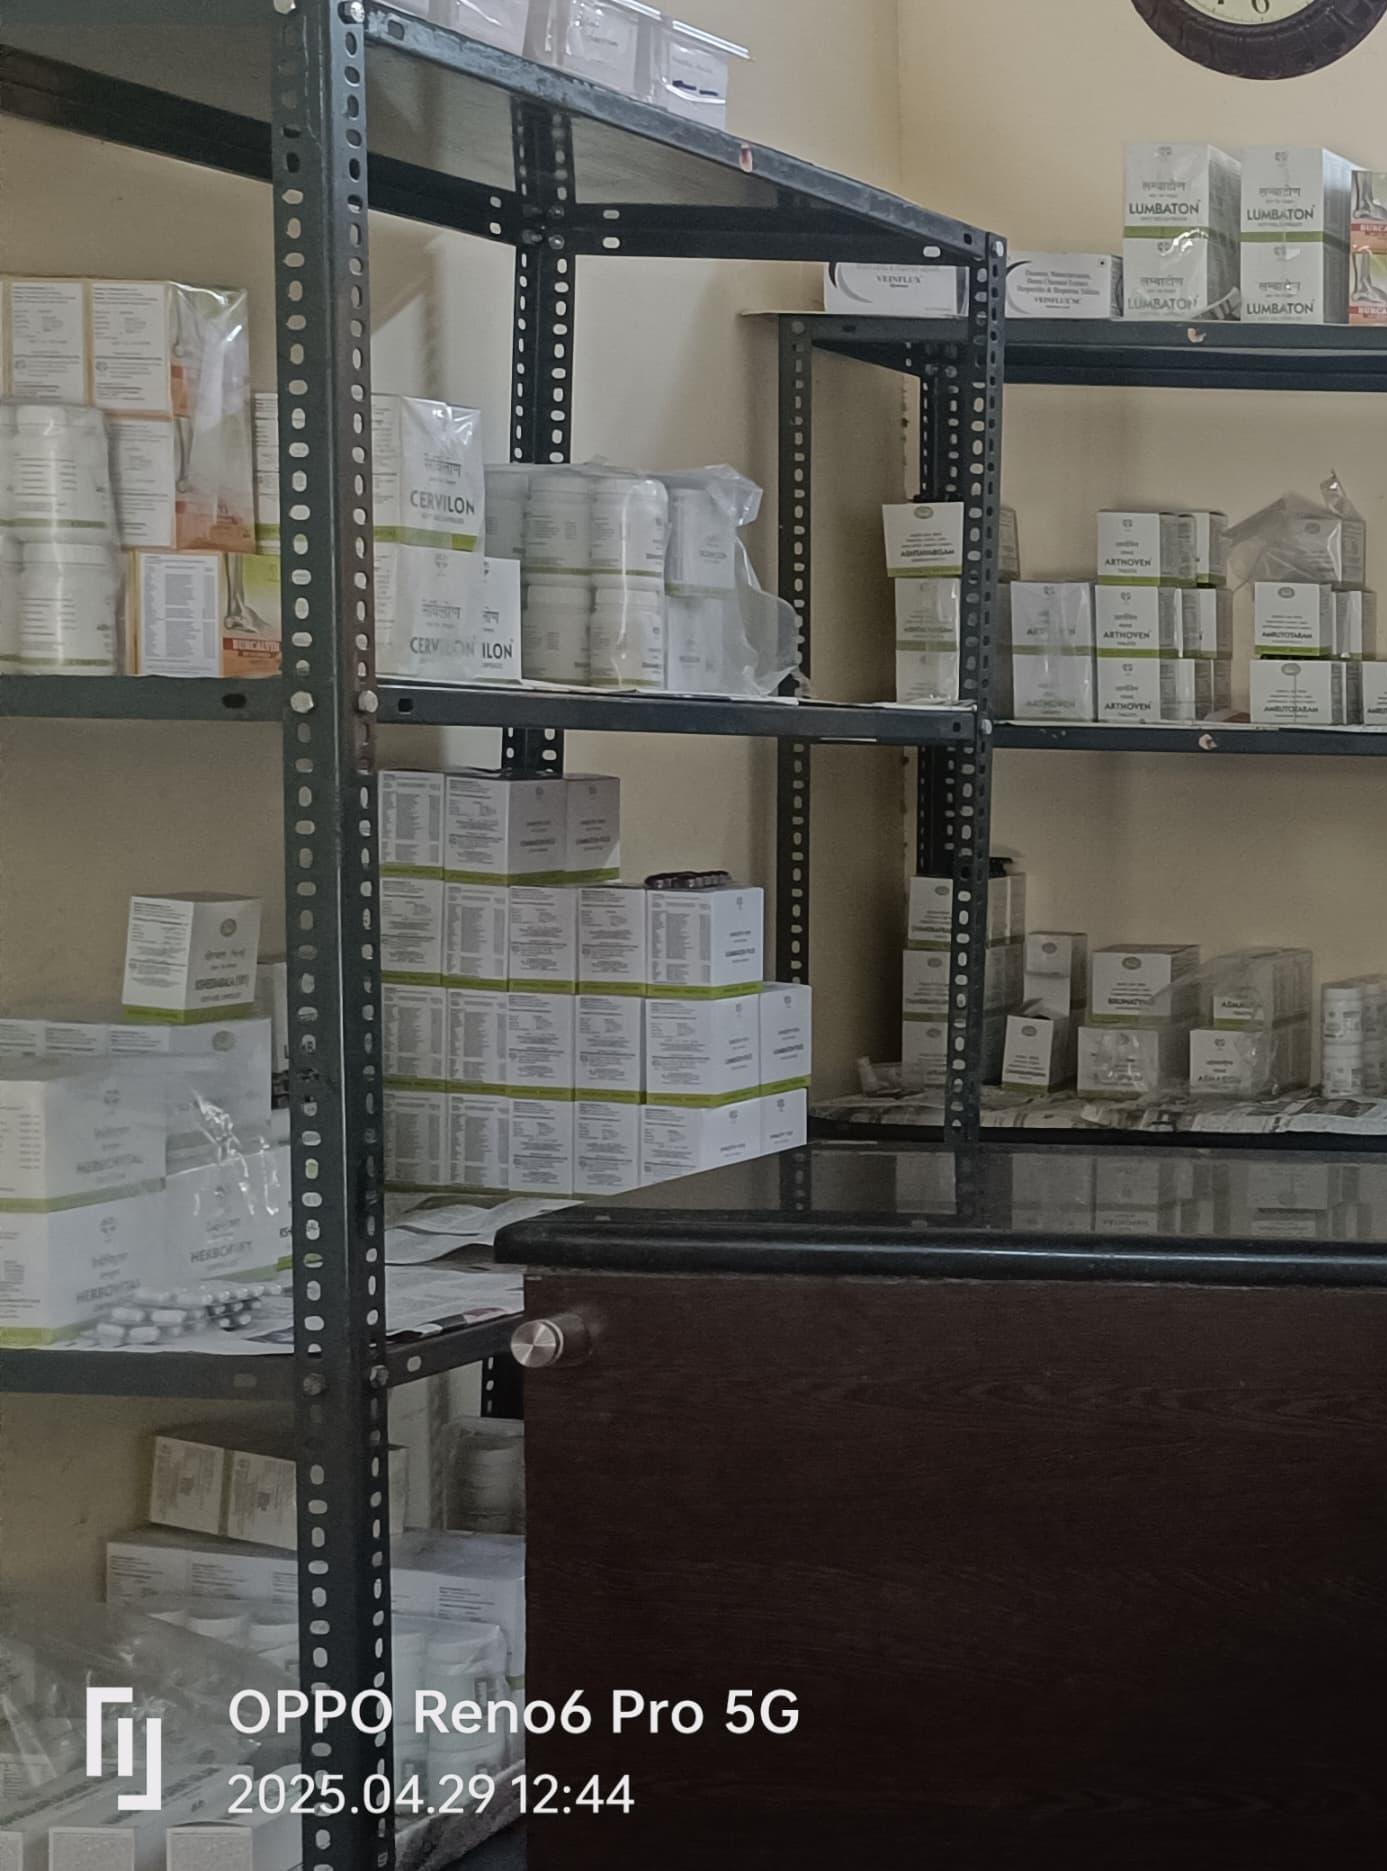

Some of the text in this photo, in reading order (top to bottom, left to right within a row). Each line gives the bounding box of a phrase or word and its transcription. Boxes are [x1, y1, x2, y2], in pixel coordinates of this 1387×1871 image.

[1128, 202, 1200, 216] LUMBATON
[1246, 208, 1315, 221] LUMBATON
[1127, 298, 1198, 311] LUMBATON
[1246, 303, 1314, 316] LUMBATON
[410, 489, 475, 516] CERVILON
[1104, 558, 1152, 567] ARTHOVEN
[1103, 631, 1151, 640] ARTHOVEN
[481, 642, 513, 659] ILON
[1104, 702, 1152, 711] ARTHOVEN
